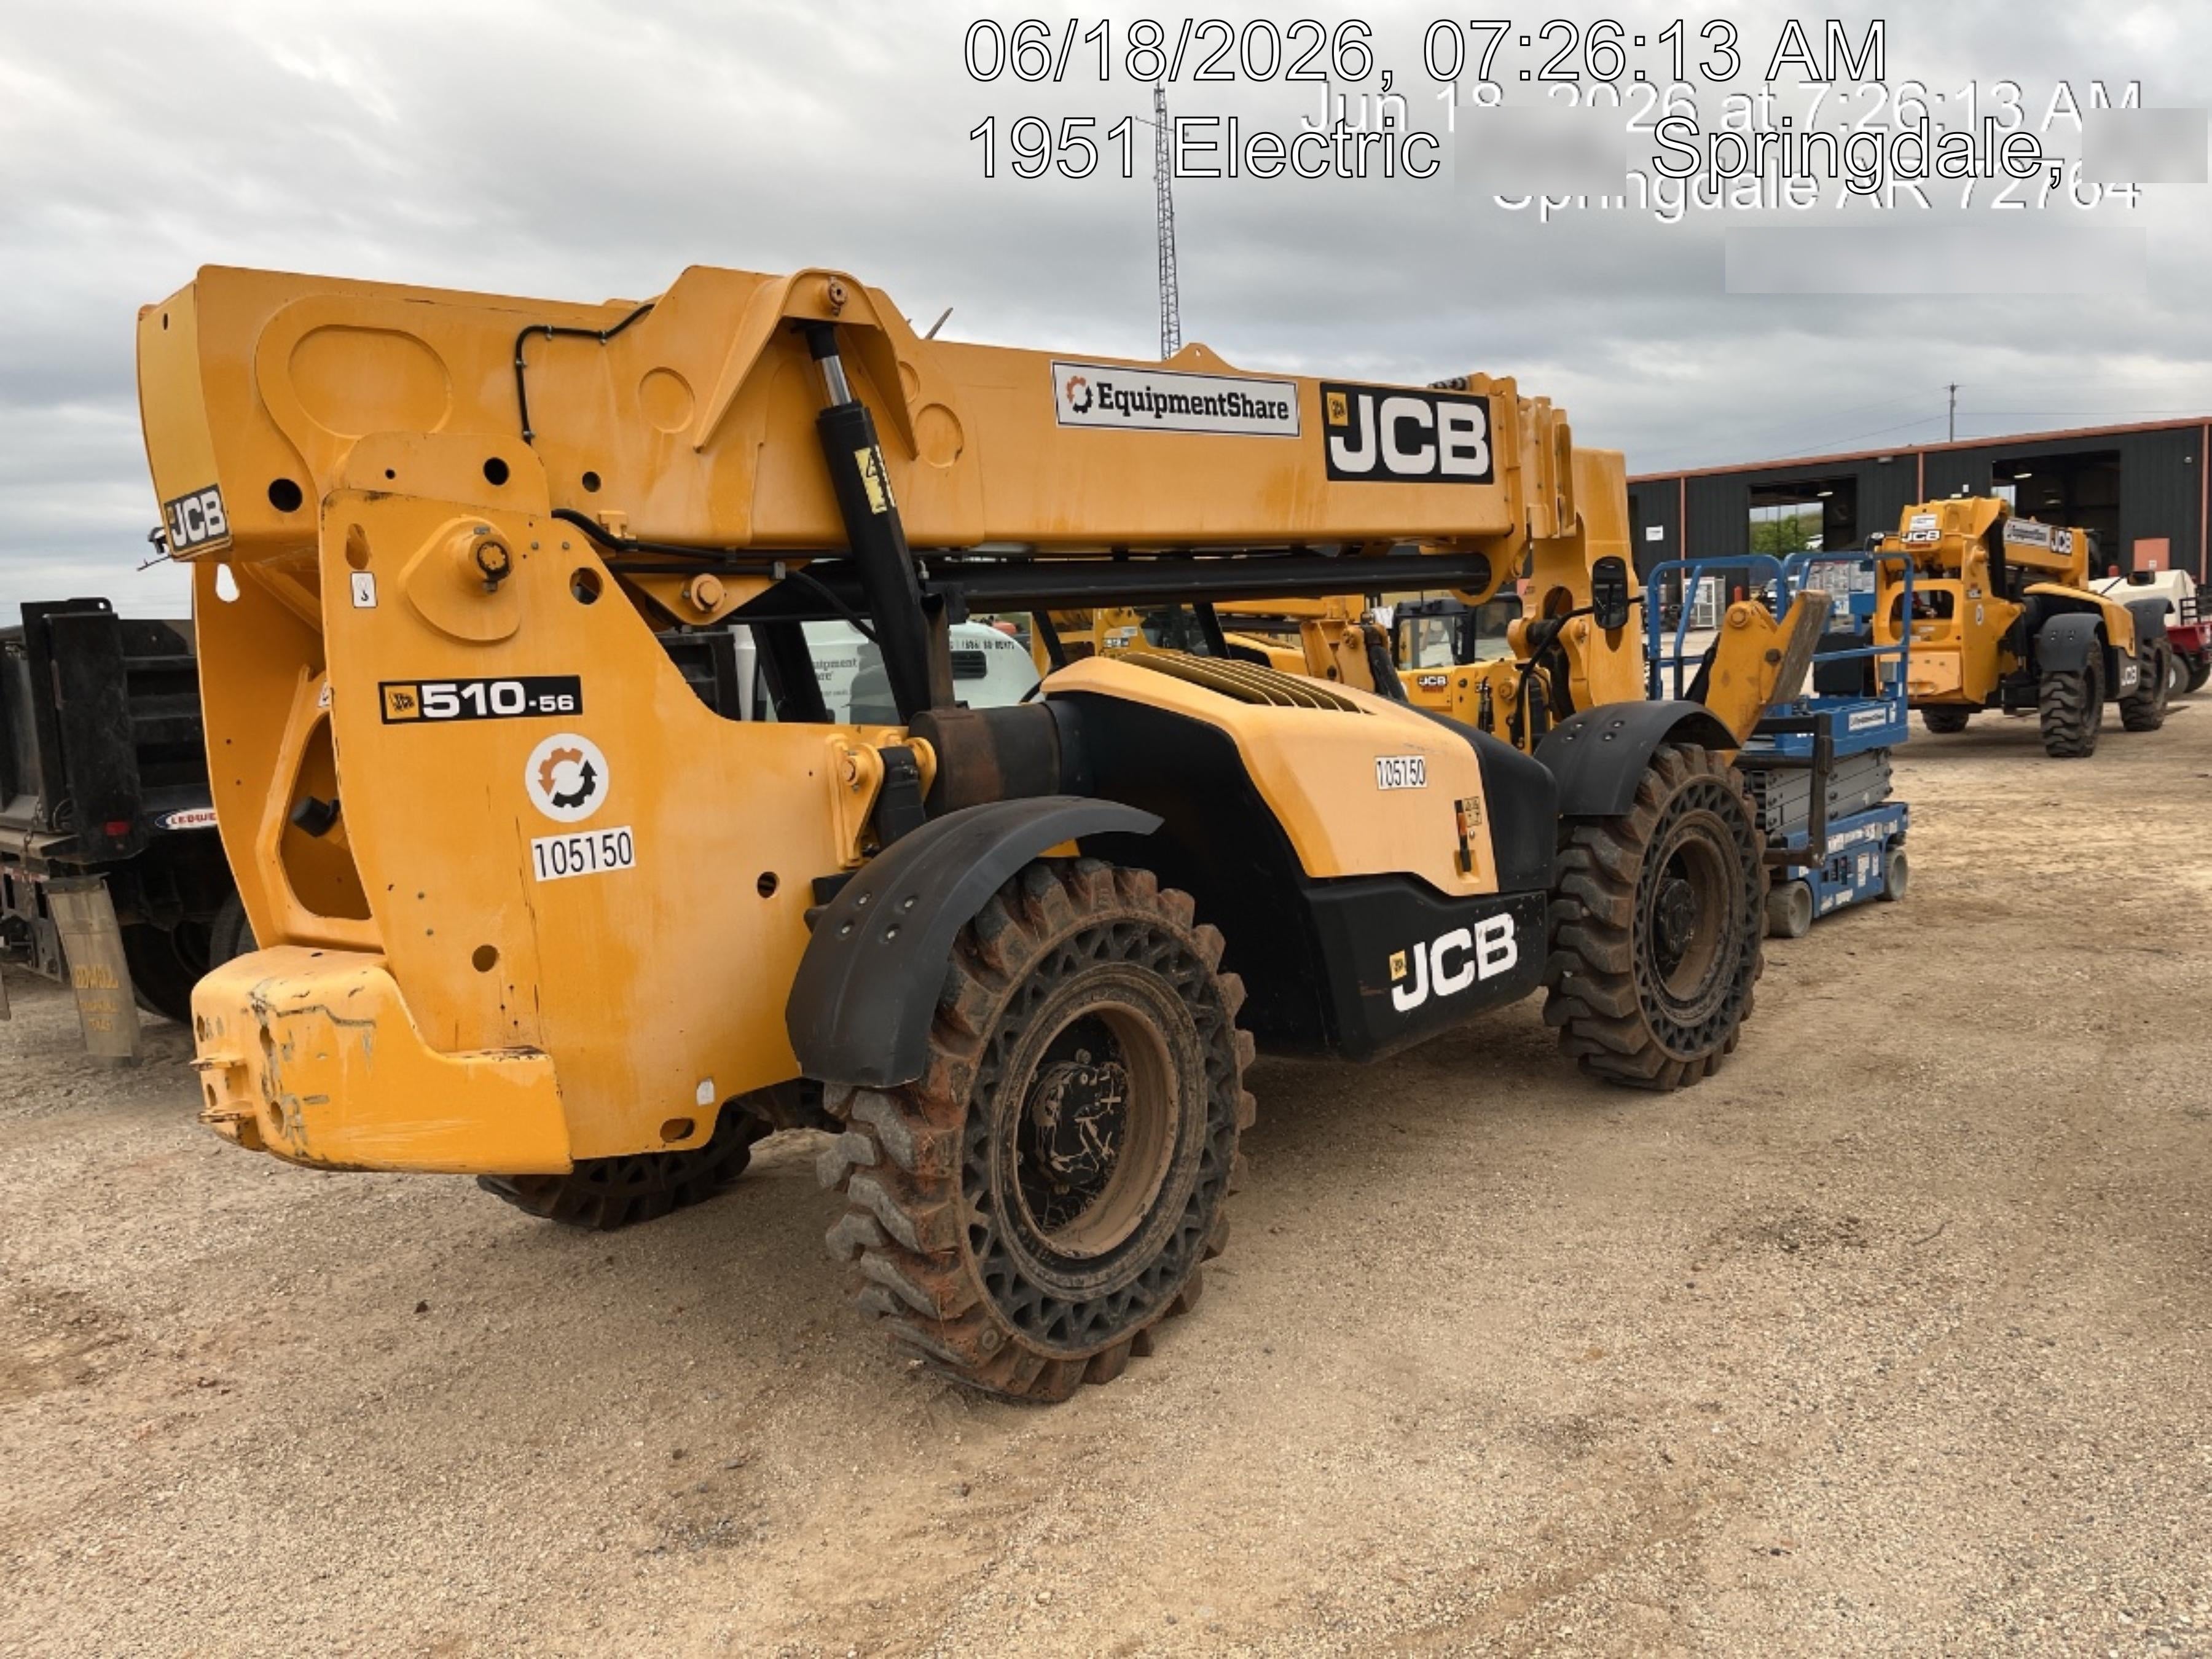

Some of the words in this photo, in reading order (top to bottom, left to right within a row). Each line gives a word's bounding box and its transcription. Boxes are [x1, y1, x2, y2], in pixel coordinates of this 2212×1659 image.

[1097, 382, 1289, 421] EquipmentShare
[1329, 394, 1489, 477] JCB
[172, 490, 226, 547] JCB
[1901, 529, 1941, 543] JCB
[2051, 529, 2072, 554] JCB
[422, 681, 575, 718] 510-56
[1418, 676, 1446, 686] JCB
[1376, 759, 1426, 786] 105150
[535, 831, 633, 878] 105150
[1391, 912, 1518, 1013] JCB
